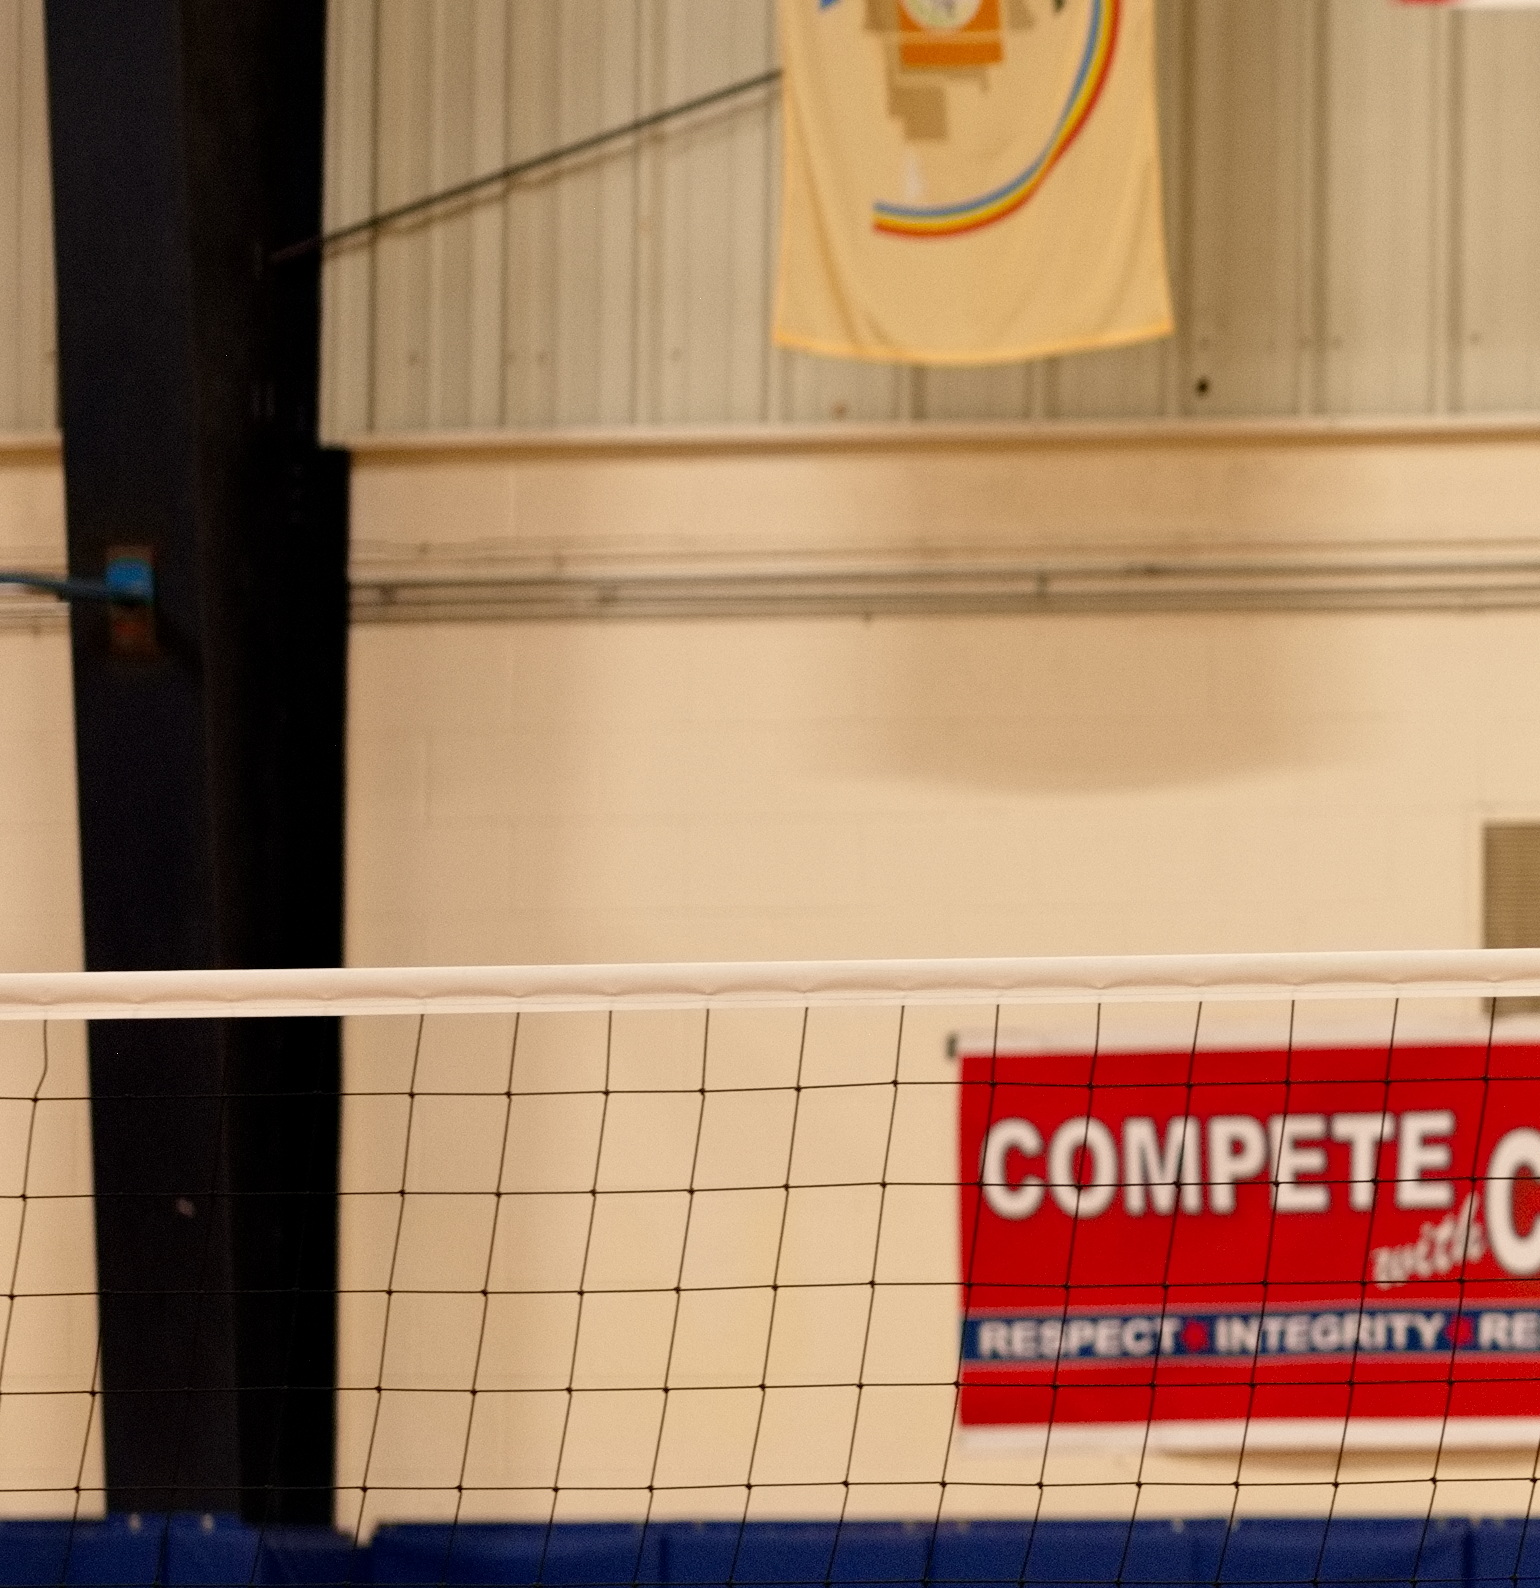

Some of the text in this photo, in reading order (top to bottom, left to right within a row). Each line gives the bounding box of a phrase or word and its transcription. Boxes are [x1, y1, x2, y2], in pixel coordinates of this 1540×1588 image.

[981, 1110, 1457, 1219] COMPETE
[978, 1317, 1181, 1358] RESPECT
[1215, 1311, 1445, 1353] INTEGRITY
